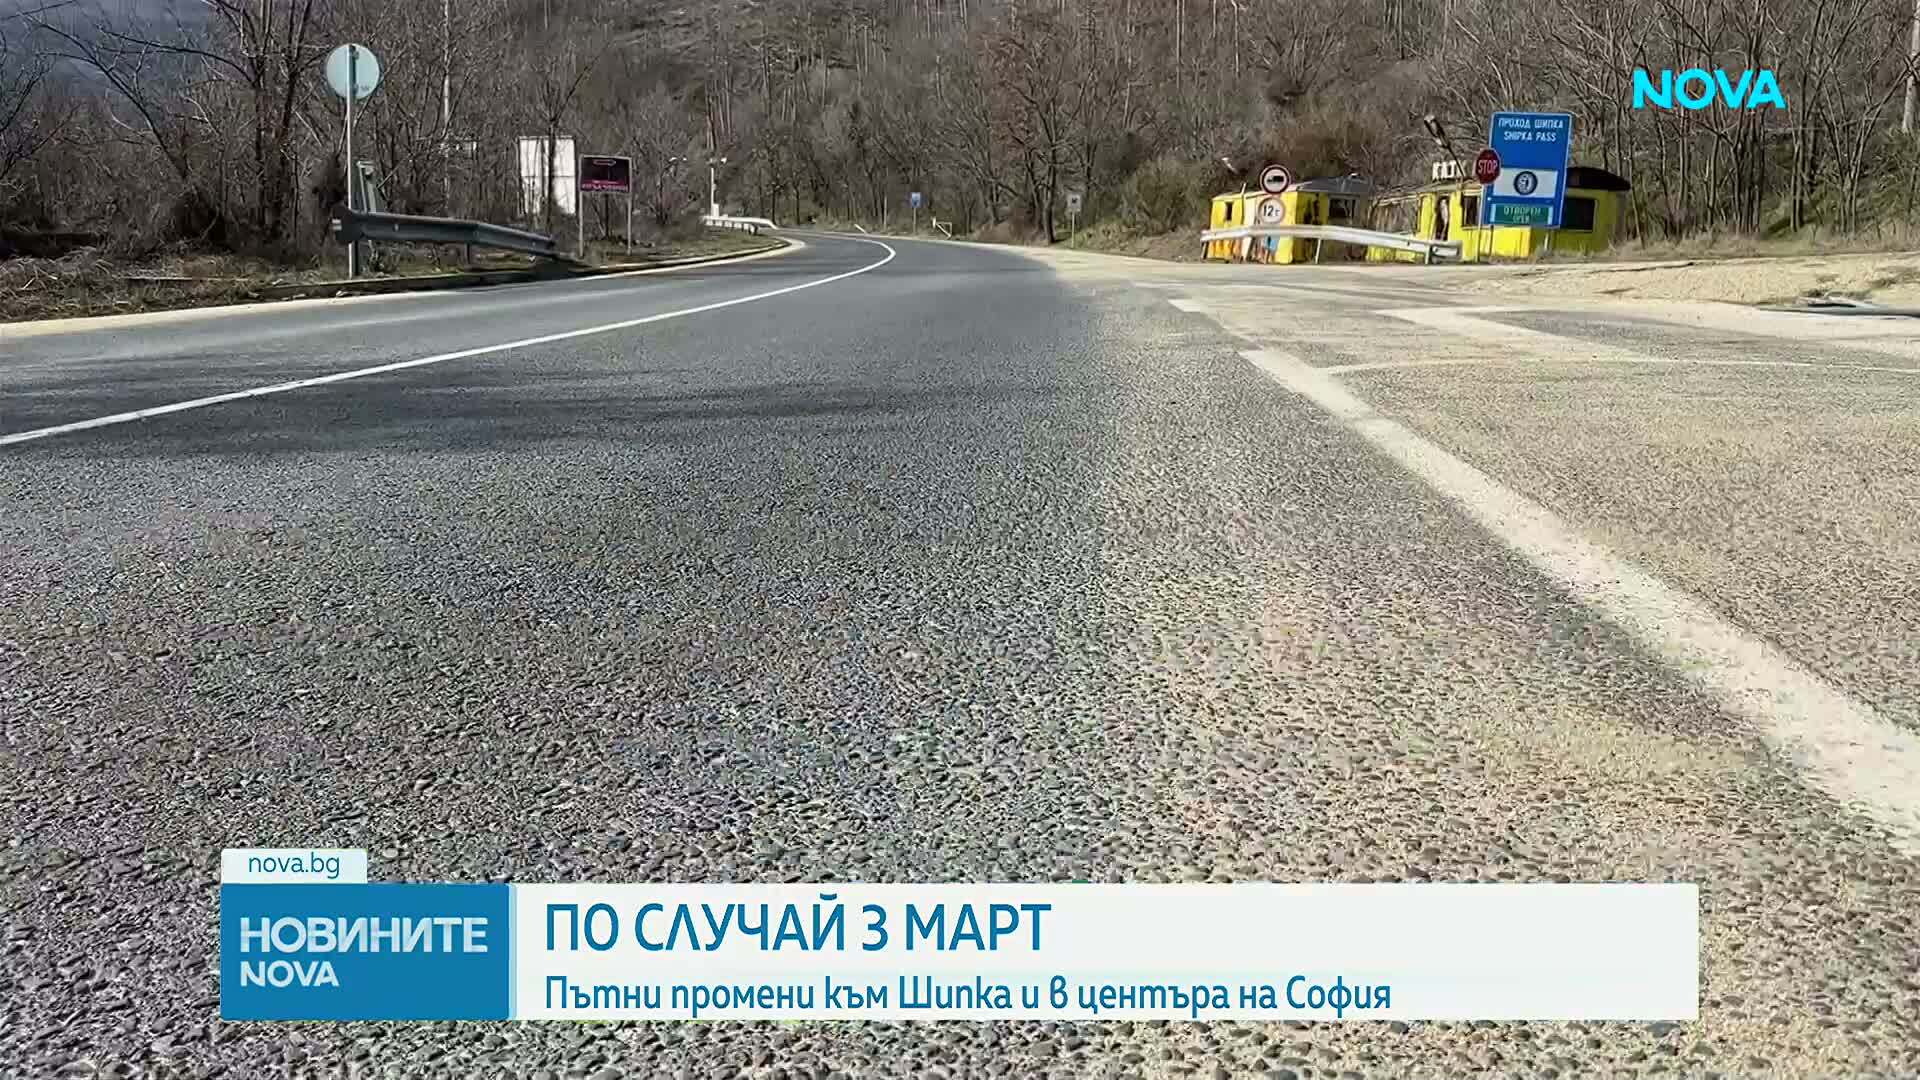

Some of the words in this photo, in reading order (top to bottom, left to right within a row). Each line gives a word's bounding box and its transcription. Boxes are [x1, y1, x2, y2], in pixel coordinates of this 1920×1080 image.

[1498, 118, 1531, 129] ПРОХОД
[1534, 119, 1564, 129] ШИПКА
[1503, 131, 1532, 141] SHIPKA
[1535, 131, 1557, 142] PASS
[1478, 159, 1498, 175] STOP
